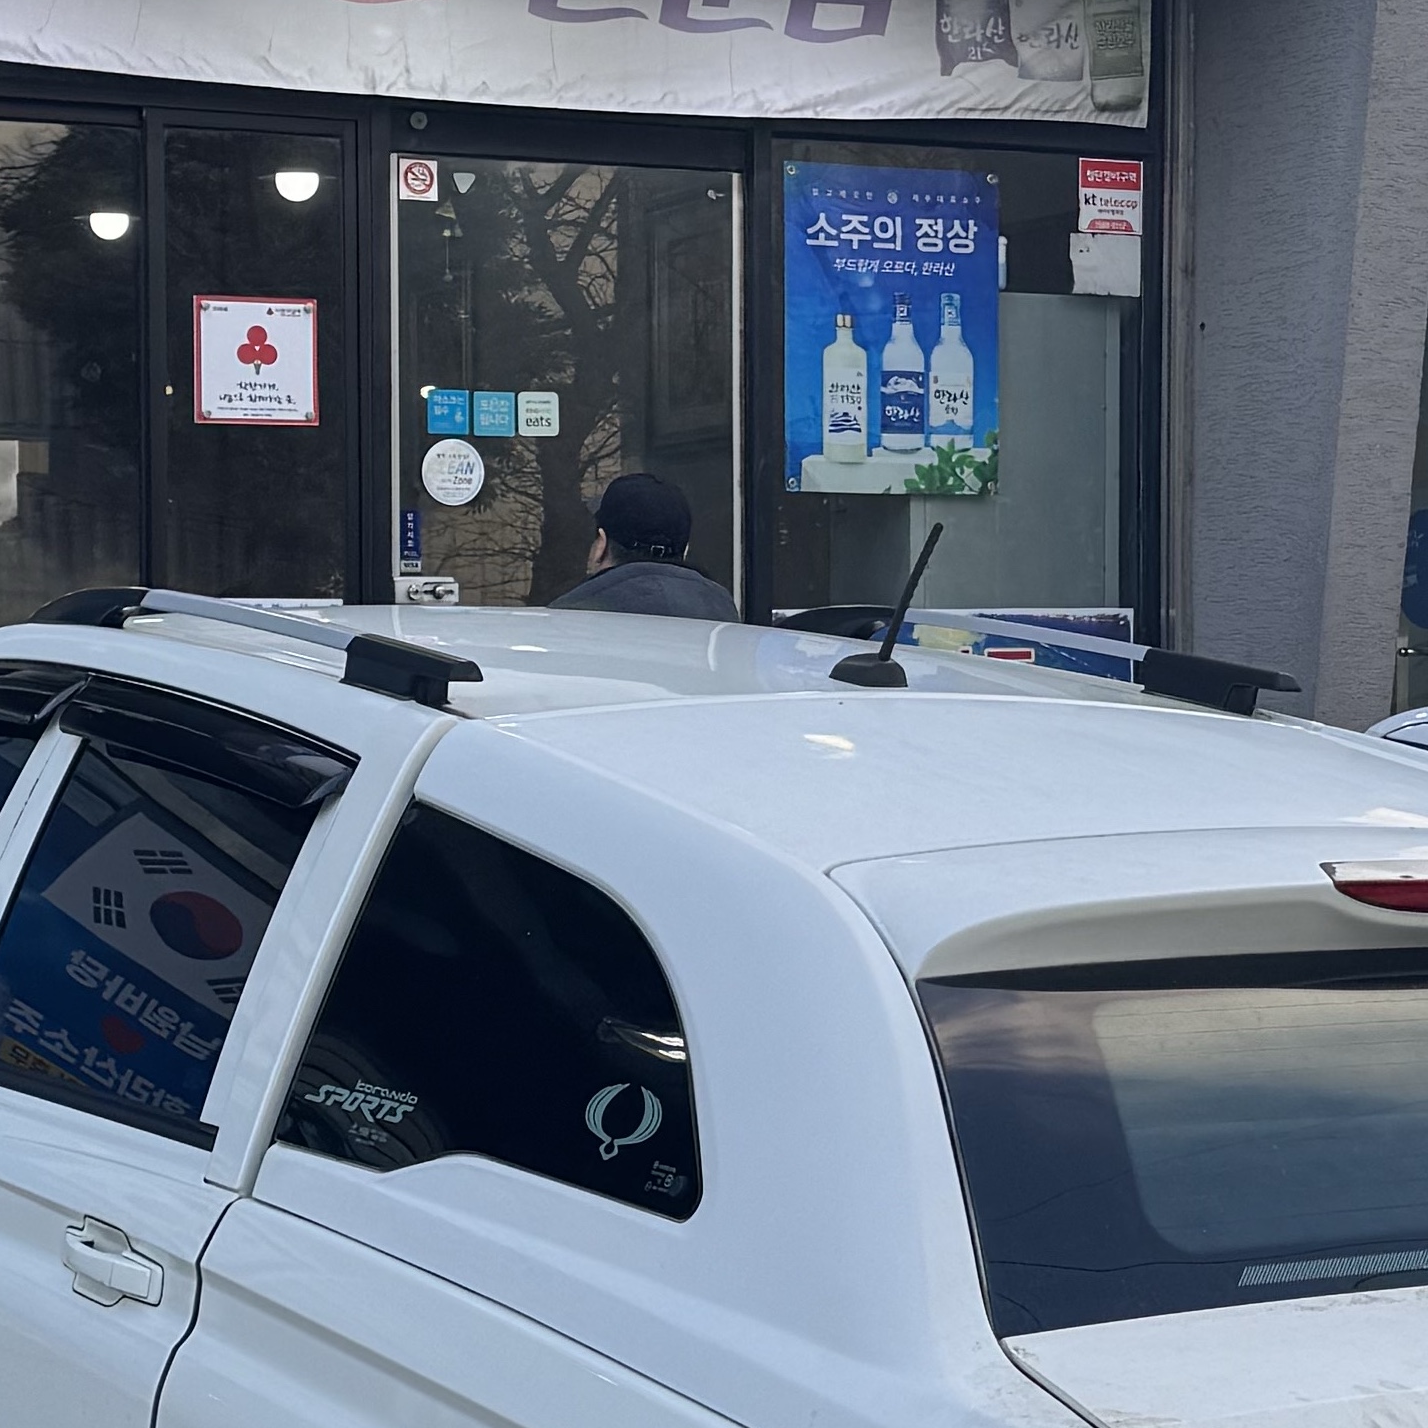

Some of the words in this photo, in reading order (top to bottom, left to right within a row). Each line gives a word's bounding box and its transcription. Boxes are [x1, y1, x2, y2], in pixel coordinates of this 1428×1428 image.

[940, 14, 1005, 43] 한라산
[1084, 193, 1097, 206] kt
[806, 212, 902, 250] 소주의
[915, 218, 978, 254] 정상
[526, 415, 551, 427] eats
[304, 1084, 415, 1124] SPORTS
[354, 1079, 419, 1104] korando
